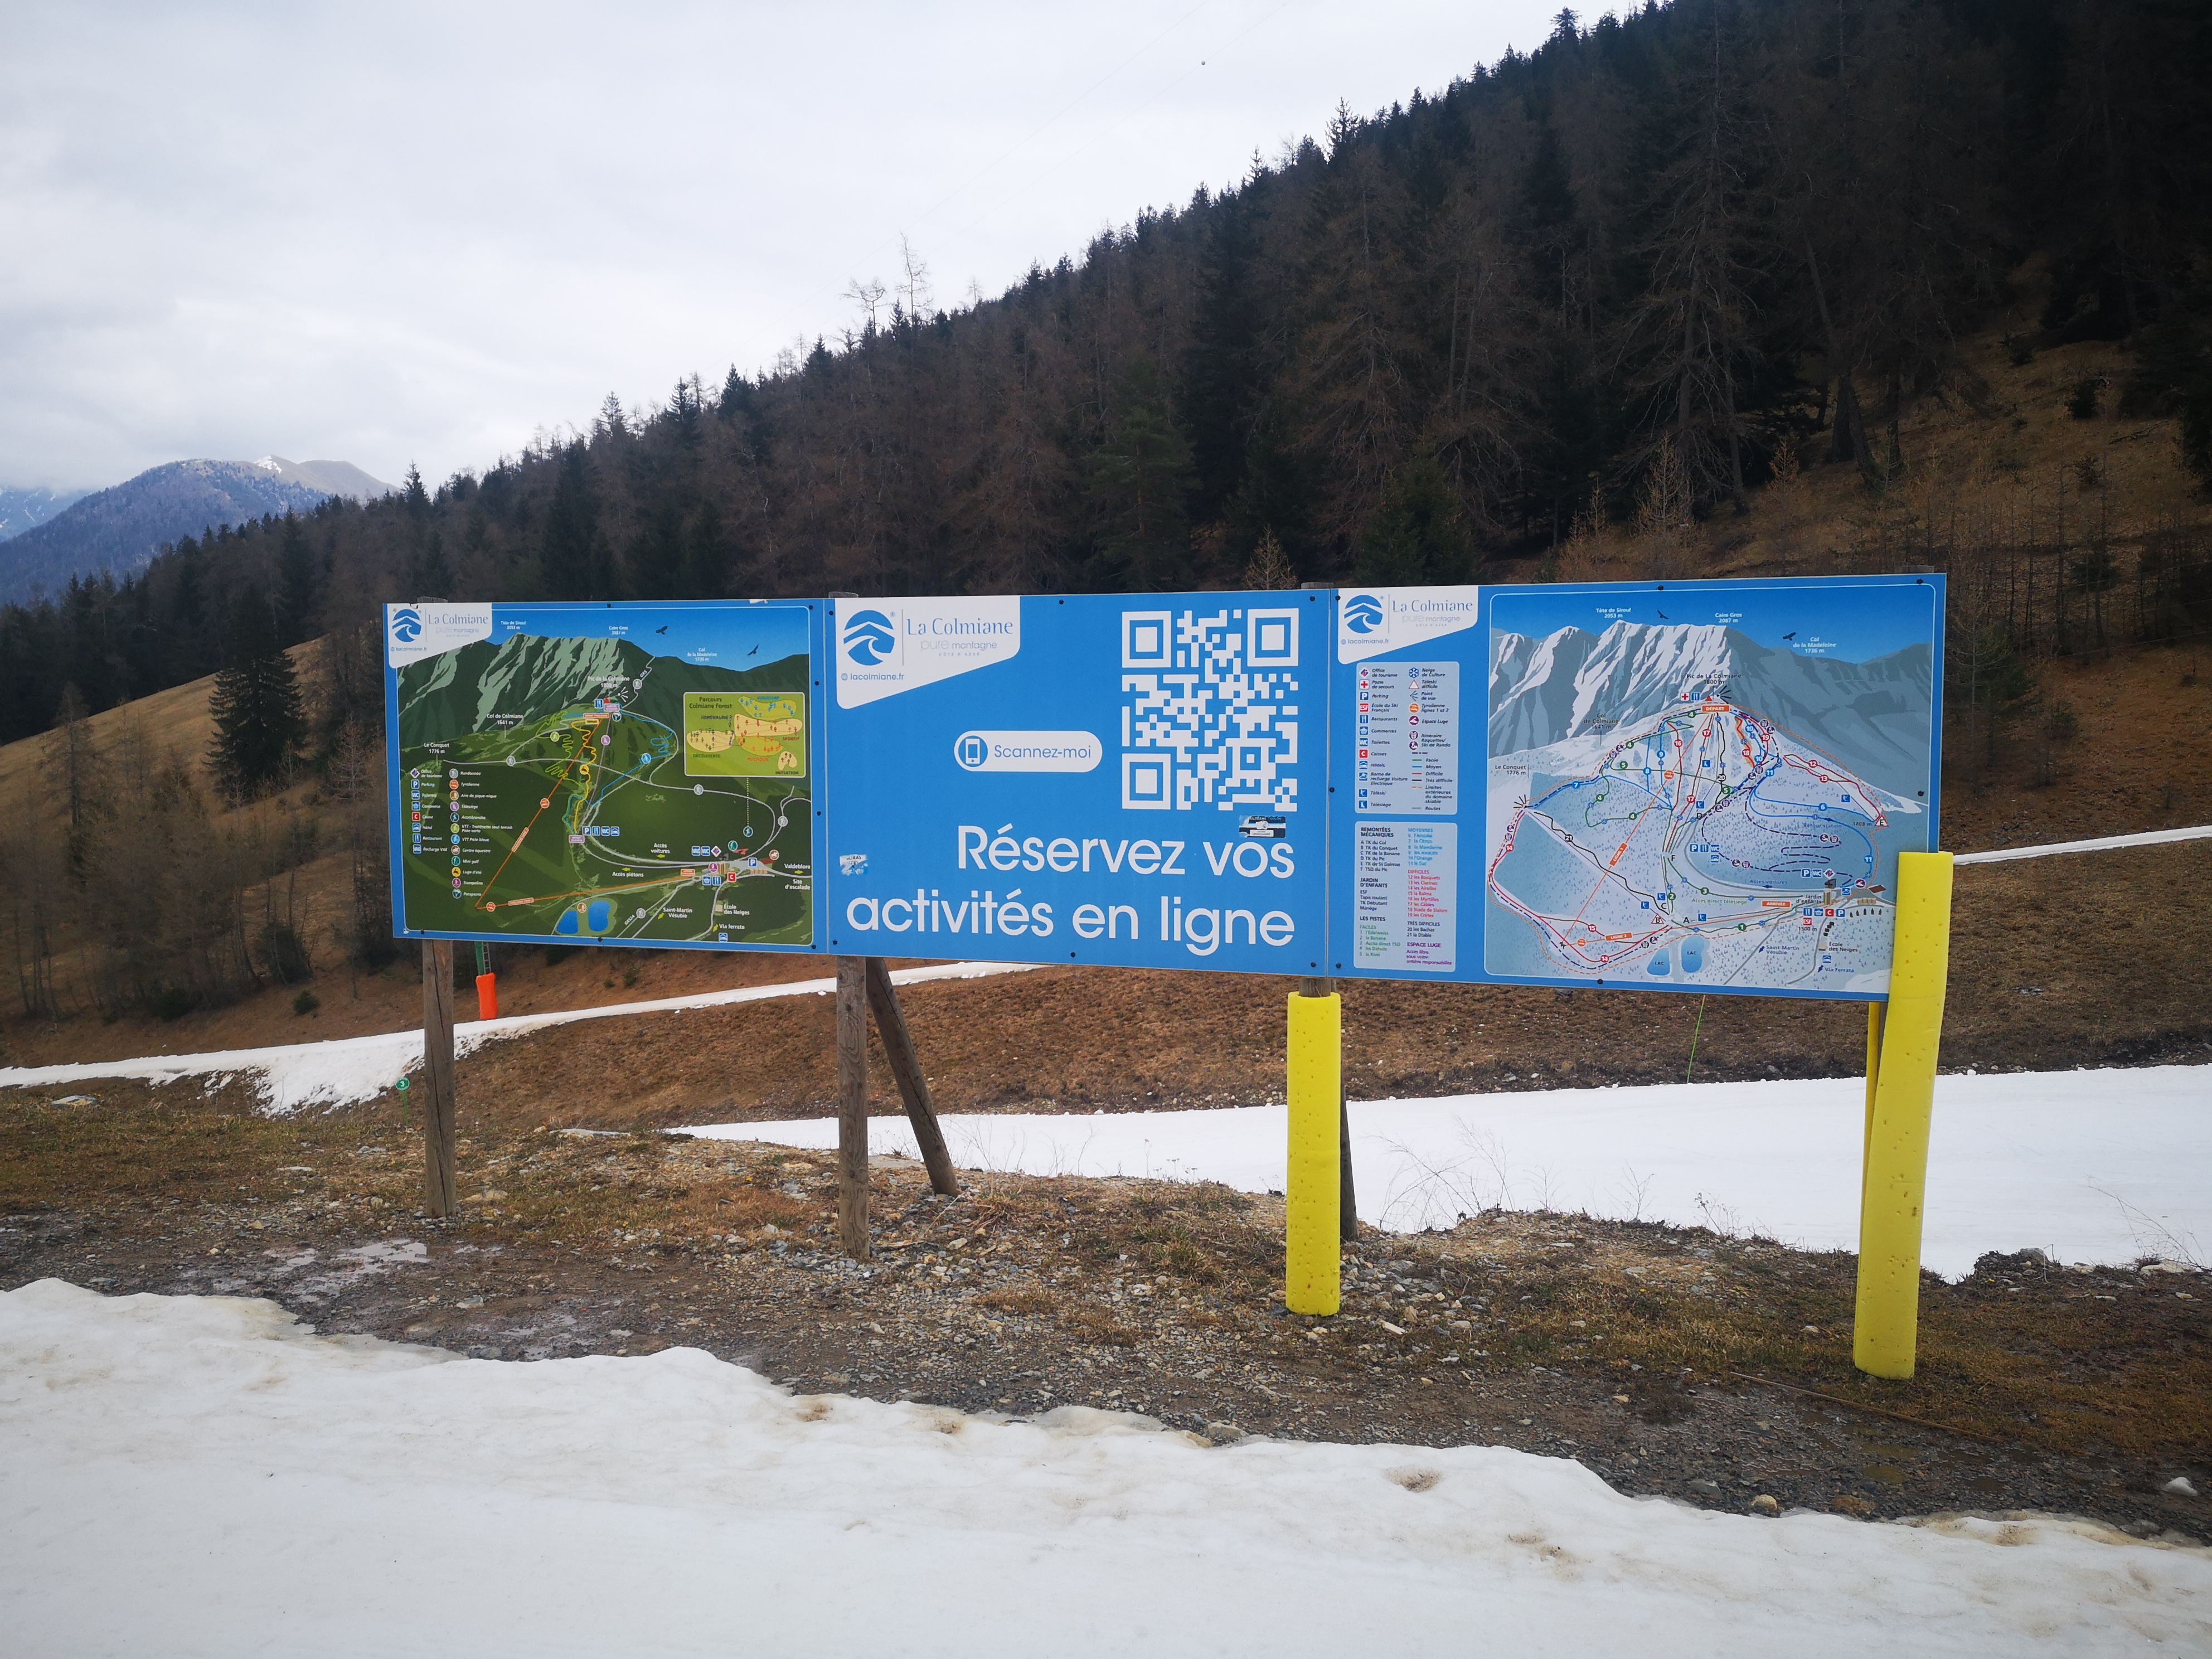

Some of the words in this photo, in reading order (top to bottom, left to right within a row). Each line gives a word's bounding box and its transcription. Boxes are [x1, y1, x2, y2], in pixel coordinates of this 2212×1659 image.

[1393, 600, 1407, 612] La
[1411, 599, 1473, 612] Colmiane
[428, 614, 439, 624] La
[443, 614, 488, 624] Colmiane
[907, 619, 926, 635] La
[933, 618, 1013, 634] Colmiane
[921, 641, 949, 651] pure
[952, 642, 997, 651] montagne
[995, 745, 1090, 758] Scannez-moi
[959, 824, 1185, 875] Réservez
[1203, 842, 1294, 878] vos
[847, 889, 1053, 936] activités
[1073, 905, 1138, 939] en
[1162, 896, 1294, 955] ligne
